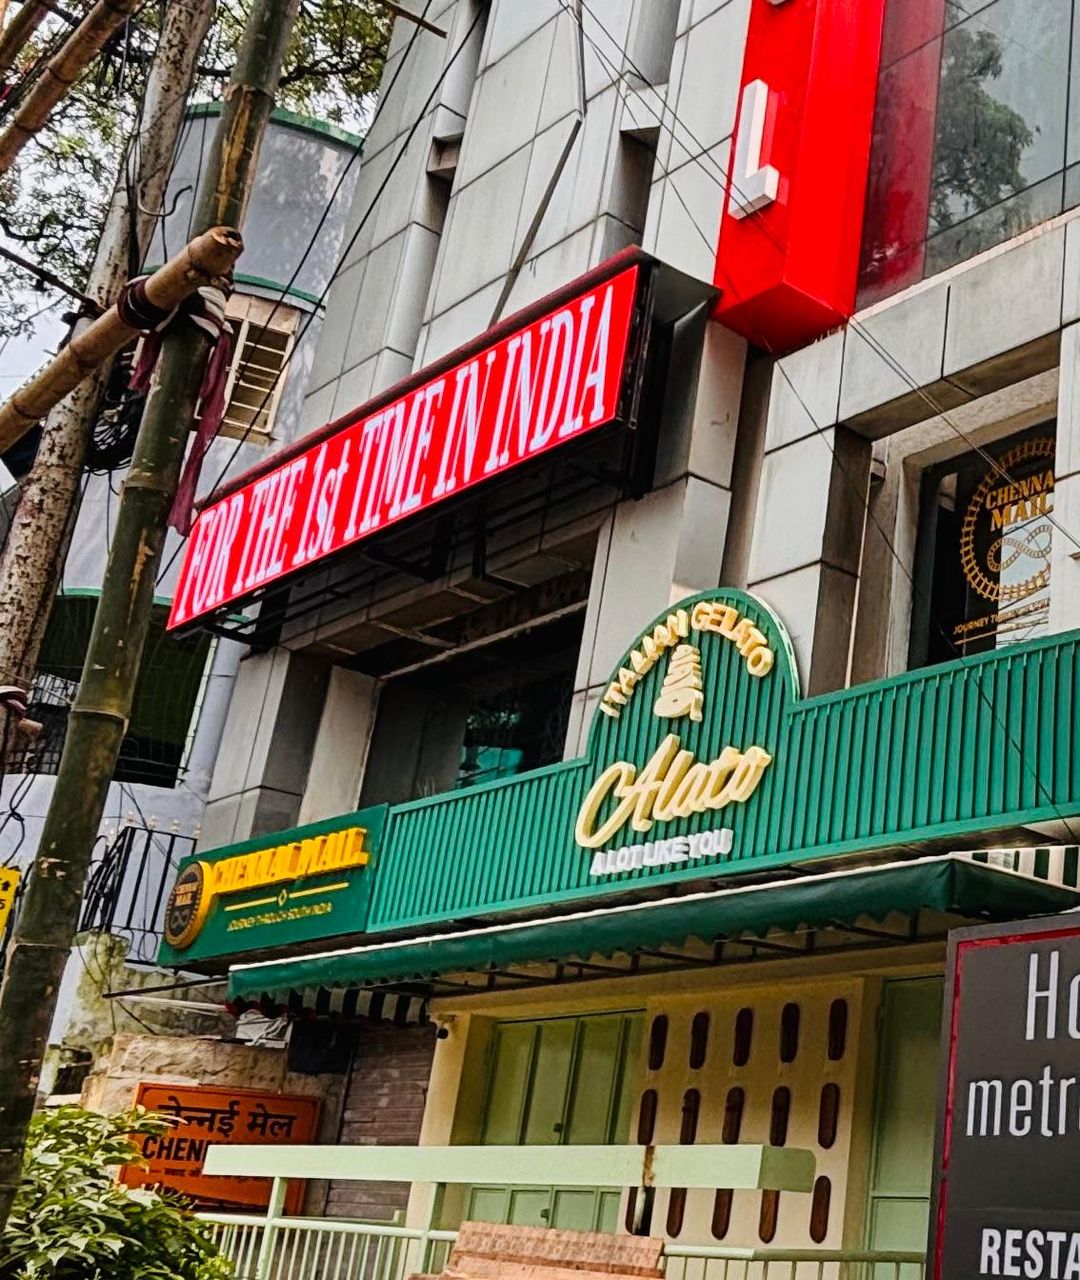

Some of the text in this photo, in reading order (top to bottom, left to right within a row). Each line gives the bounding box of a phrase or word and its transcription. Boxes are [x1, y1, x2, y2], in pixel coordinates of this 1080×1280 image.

[175, 284, 614, 620] FOR THE 1st TIME IN INDIA
[985, 470, 1055, 510] CHENNA
[990, 492, 1054, 532] MAIL
[599, 602, 775, 718] ITALIAN GELATO
[643, 836, 689, 866] LIKE
[687, 828, 733, 859] YOU
[247, 1102, 298, 1139] मेल
[141, 1135, 213, 1162] CHEN
